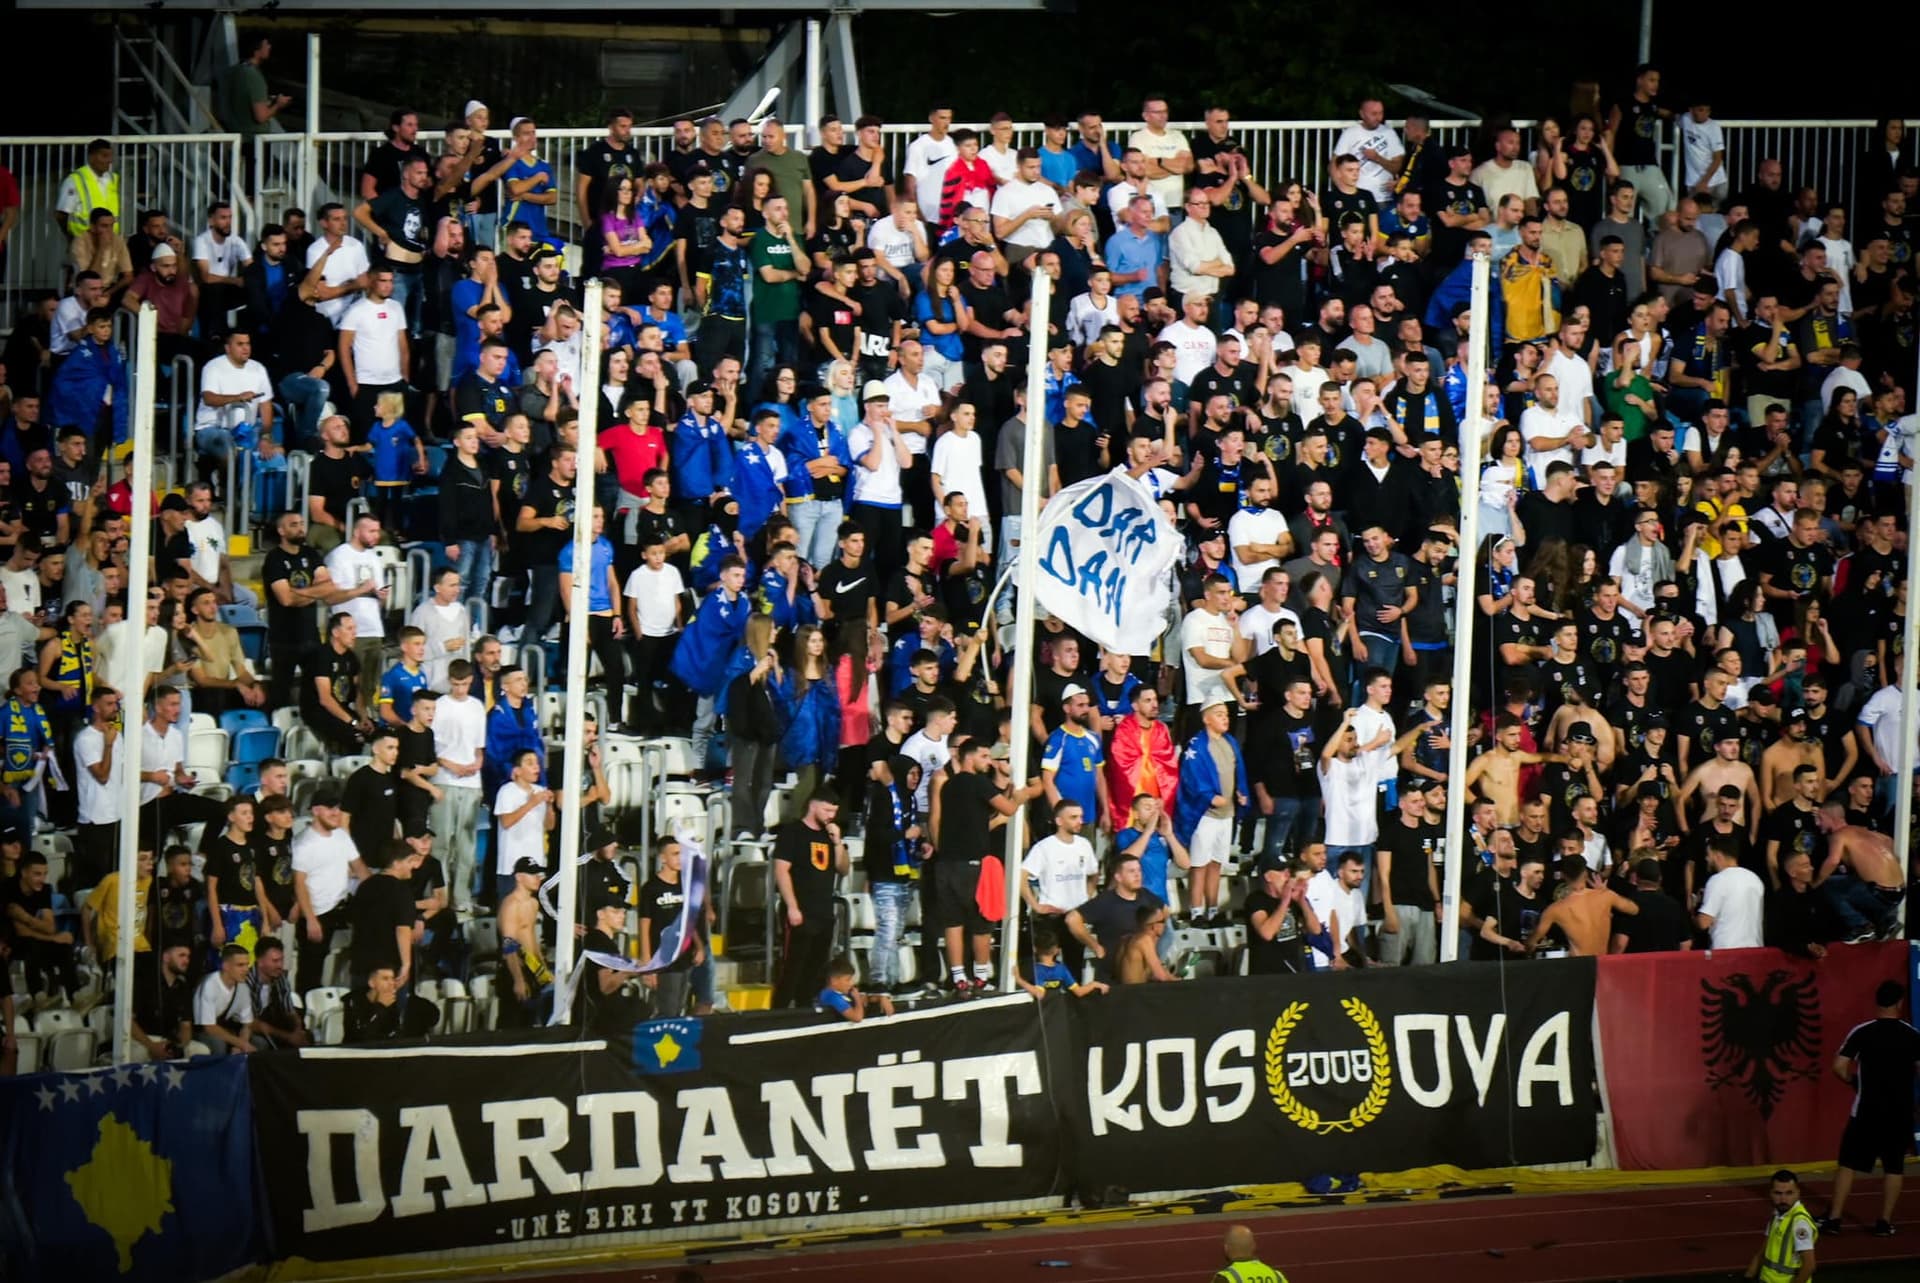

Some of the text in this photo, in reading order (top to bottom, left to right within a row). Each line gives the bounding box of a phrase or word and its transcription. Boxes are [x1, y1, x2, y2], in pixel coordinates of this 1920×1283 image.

[1287, 1050, 1372, 1087] 2008
[297, 1050, 1042, 1233] DARDANËT
[586, 1203, 653, 1230] BIRI
[671, 1199, 708, 1222] YT
[726, 1186, 841, 1219] KOSOVË
